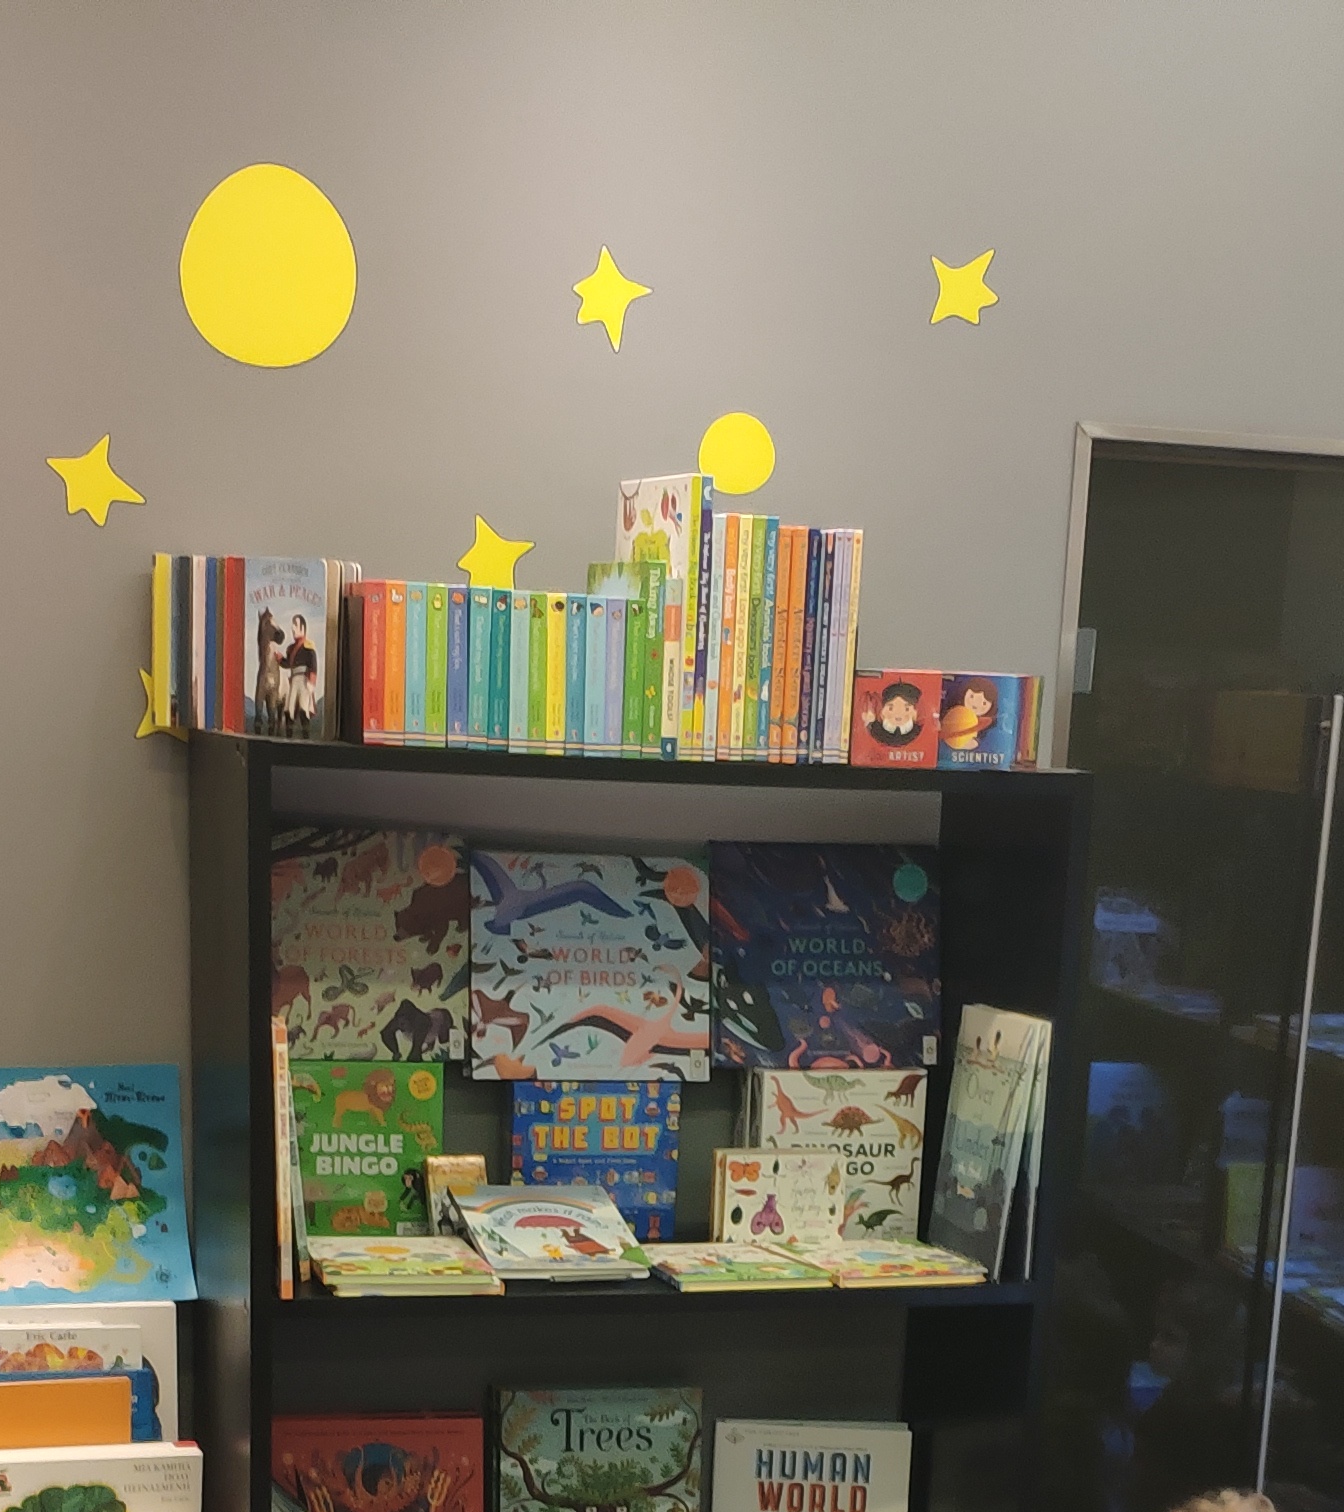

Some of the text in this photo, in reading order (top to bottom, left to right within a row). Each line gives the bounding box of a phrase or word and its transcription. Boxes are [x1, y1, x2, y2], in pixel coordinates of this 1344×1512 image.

[253, 586, 277, 604] WAR
[278, 585, 286, 597] &
[888, 750, 924, 761] ARTIST
[951, 751, 1005, 764] SCIENTIST
[306, 923, 388, 941] WORLD
[788, 937, 867, 954] WORLD
[286, 948, 406, 964] OF FORESTS
[551, 946, 639, 964] WORLD
[770, 959, 884, 977] OF OCEANS
[547, 970, 637, 987] OF BIRDS
[558, 1096, 637, 1122] SPOT
[310, 1133, 404, 1155] JUNGLE
[533, 1125, 660, 1151] THE BOT
[316, 1155, 399, 1176] BINGO
[26, 1331, 78, 1341] Eric Carle
[551, 1408, 653, 1453] Trees
[755, 1448, 871, 1484] HUMAN
